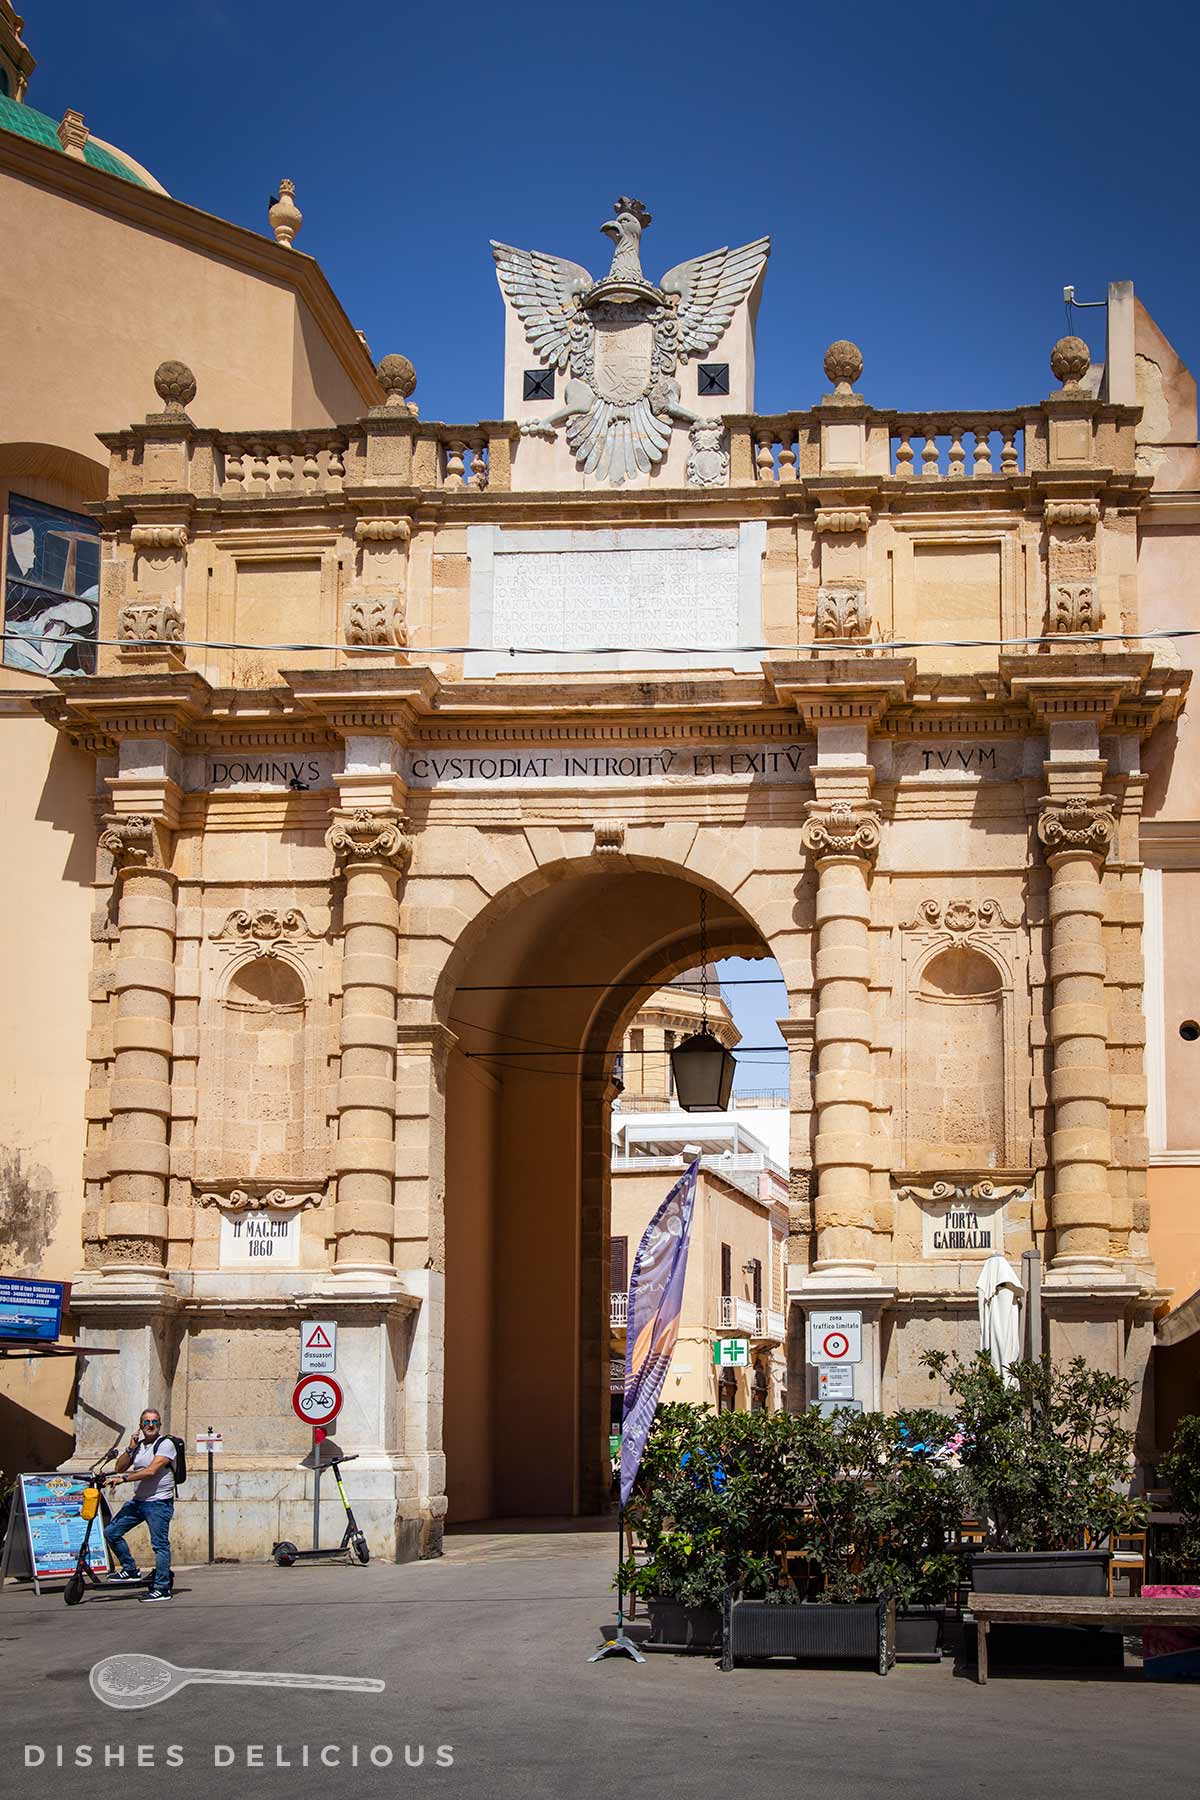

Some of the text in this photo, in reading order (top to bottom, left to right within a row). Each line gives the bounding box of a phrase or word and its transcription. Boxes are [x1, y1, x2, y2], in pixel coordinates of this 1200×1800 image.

[412, 757, 554, 781] CVSTODIAT
[693, 754, 724, 776] ET
[922, 748, 996, 770] TVVM
[247, 1220, 288, 1238] MAGGIO
[945, 1212, 978, 1229] PORTA
[249, 1240, 273, 1257] 1860
[934, 1231, 991, 1249] GARIBALDI
